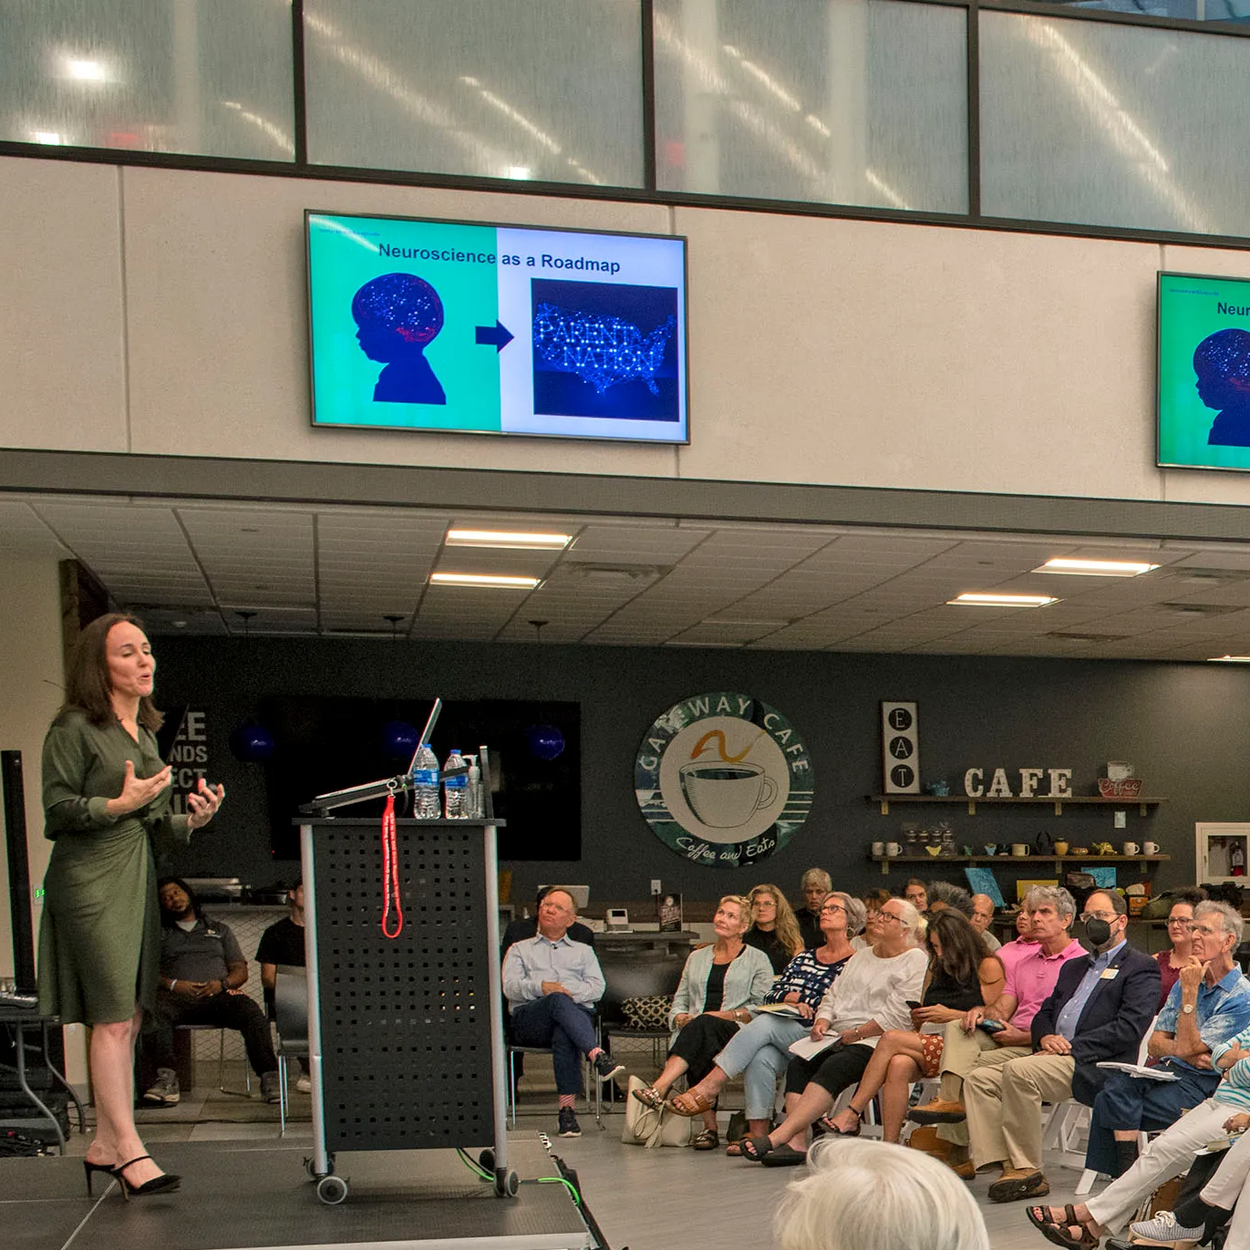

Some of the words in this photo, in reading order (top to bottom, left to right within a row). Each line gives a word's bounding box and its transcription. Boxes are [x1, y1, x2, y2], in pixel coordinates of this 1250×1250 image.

[378, 243, 496, 265] Neuroscience
[501, 251, 521, 266] as
[526, 254, 536, 267] a
[542, 254, 621, 274] Roadmap
[539, 320, 635, 346] PARENT
[563, 347, 656, 371] NATION
[641, 696, 751, 772] GATEWAY
[763, 713, 810, 773] CAFE
[893, 707, 908, 787] EAT
[964, 768, 1073, 798] CAFE
[1098, 778, 1140, 796] Coffee
[676, 836, 717, 860] Coffee
[719, 844, 741, 860] and
[746, 837, 776, 858] Eats
